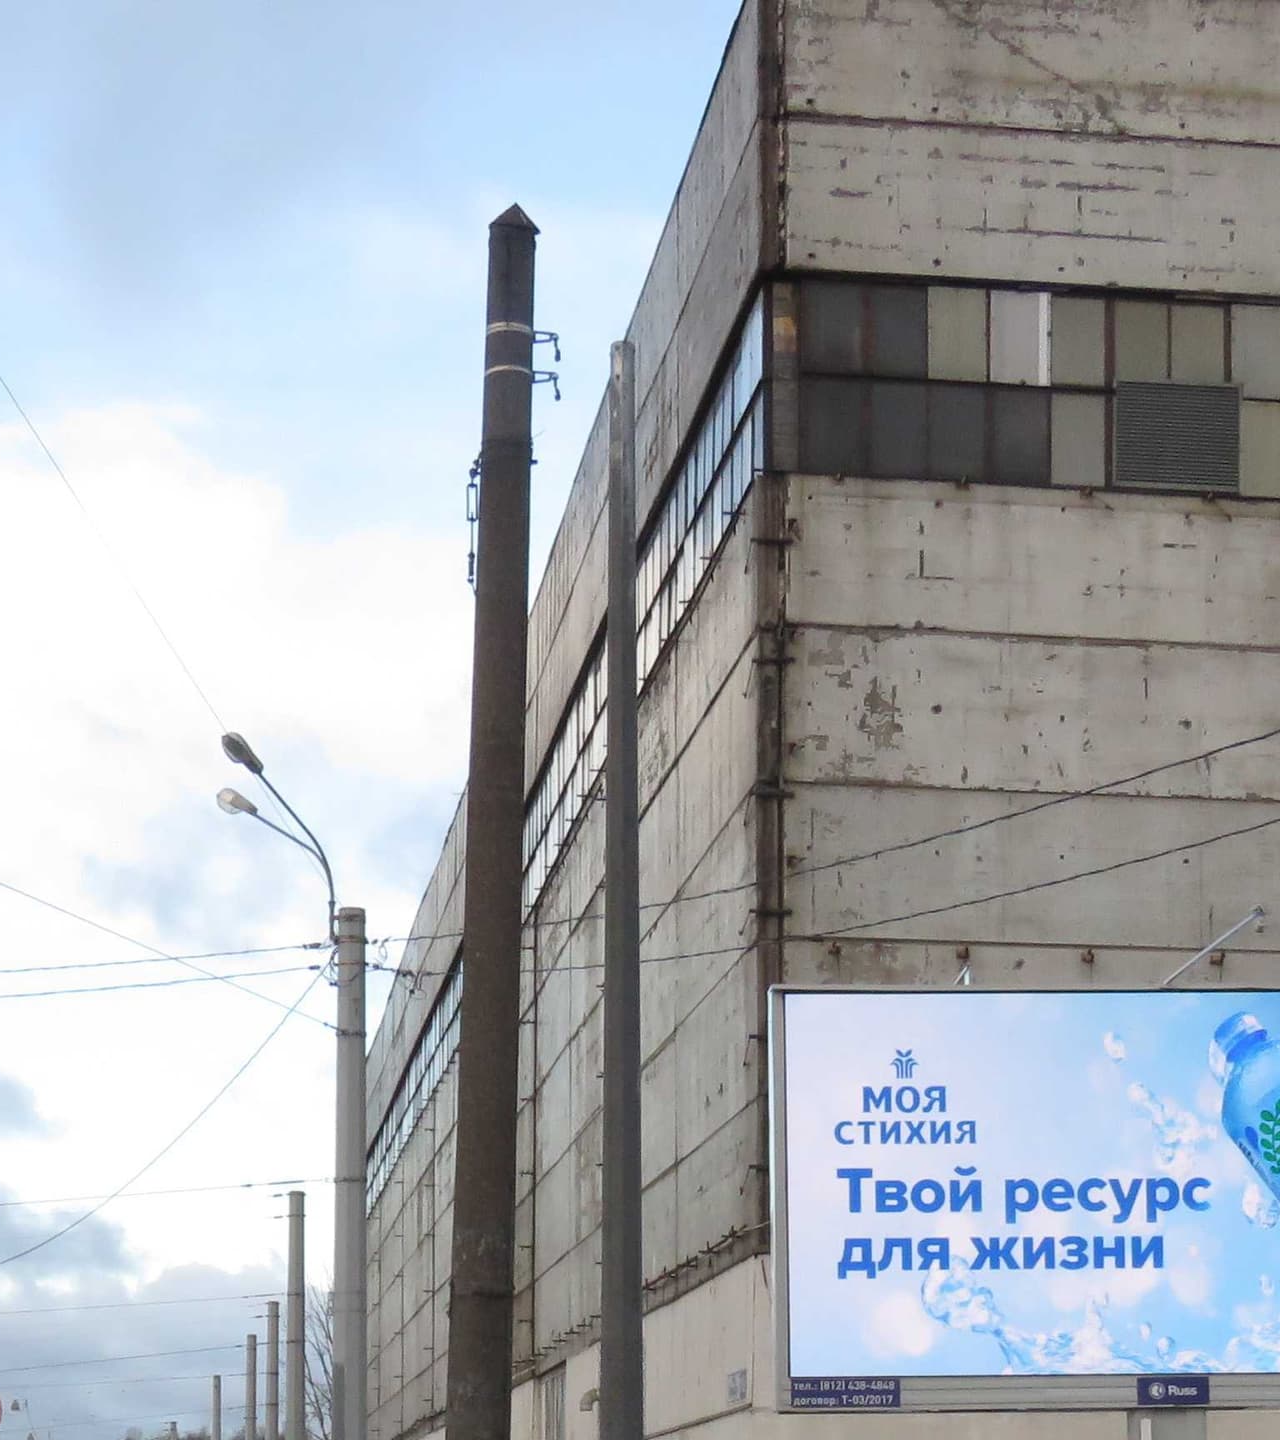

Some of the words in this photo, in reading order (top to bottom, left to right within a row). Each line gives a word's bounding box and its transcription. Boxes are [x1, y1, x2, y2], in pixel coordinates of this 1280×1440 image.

[862, 1086, 947, 1113] МОЯ
[834, 1120, 976, 1145] СТИХИЯ
[836, 1165, 983, 1213] Твой
[1004, 1176, 1211, 1224] ресурс
[837, 1237, 950, 1279] для
[969, 1235, 1164, 1270] жизни
[1168, 1385, 1198, 1396] Russ
